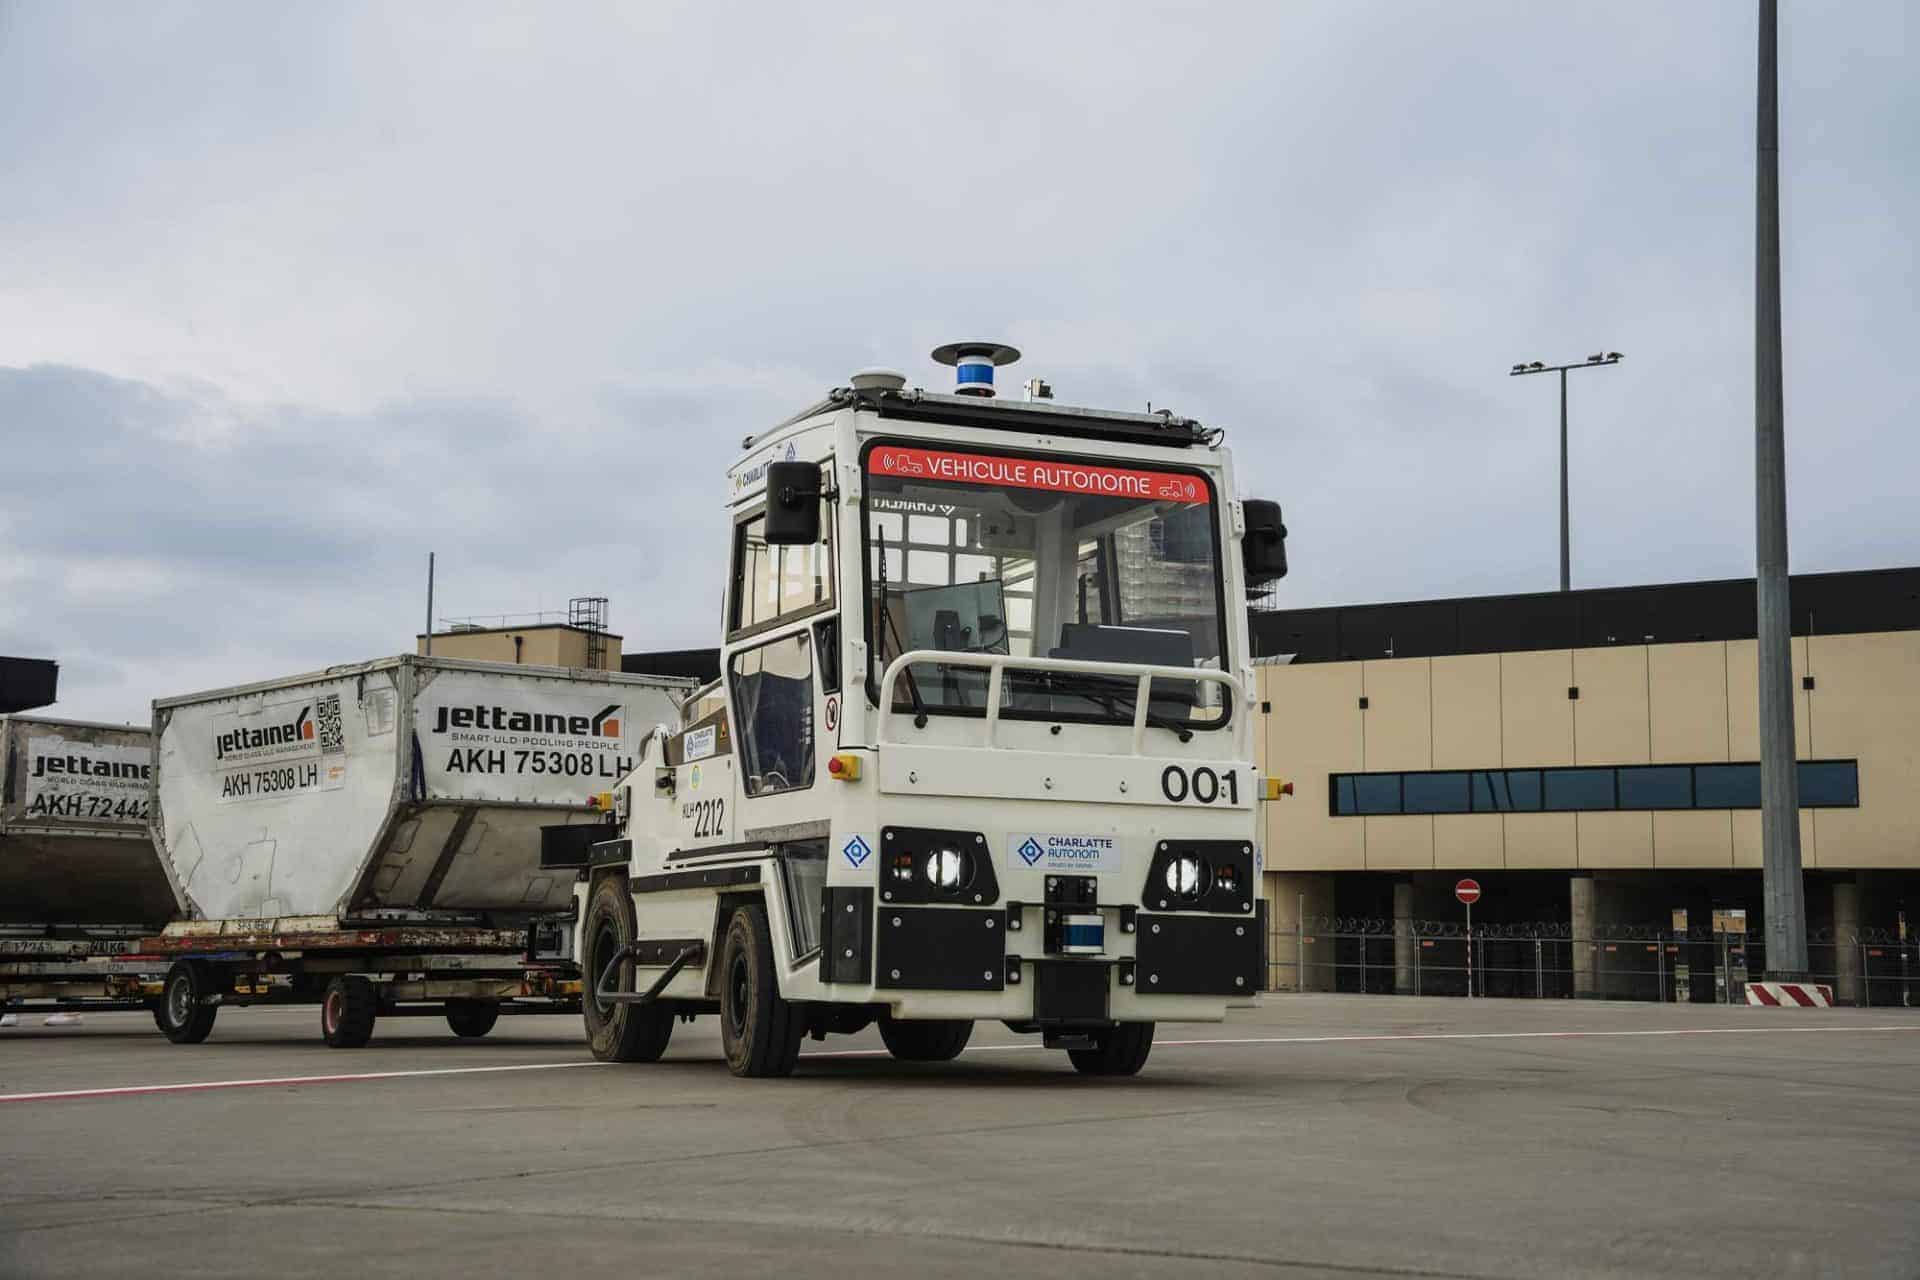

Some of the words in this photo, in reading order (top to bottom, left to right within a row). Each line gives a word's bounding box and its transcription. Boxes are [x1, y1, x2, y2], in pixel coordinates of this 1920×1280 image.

[926, 457, 1027, 483] VEHICULE
[1033, 467, 1152, 495] AUTONOME
[216, 706, 314, 760] jettainer
[432, 705, 622, 738] jettainer
[32, 755, 150, 779] jettaine
[222, 772, 251, 798] AKH
[255, 767, 295, 793] 75308
[299, 763, 318, 788] LH
[446, 748, 505, 775] AKH
[514, 751, 593, 777] 75308
[599, 754, 632, 779] LH
[1161, 765, 1239, 805] 001
[30, 793, 82, 817] AKH
[694, 798, 725, 838] 2212
[1047, 836, 1113, 849] CHARLATTE
